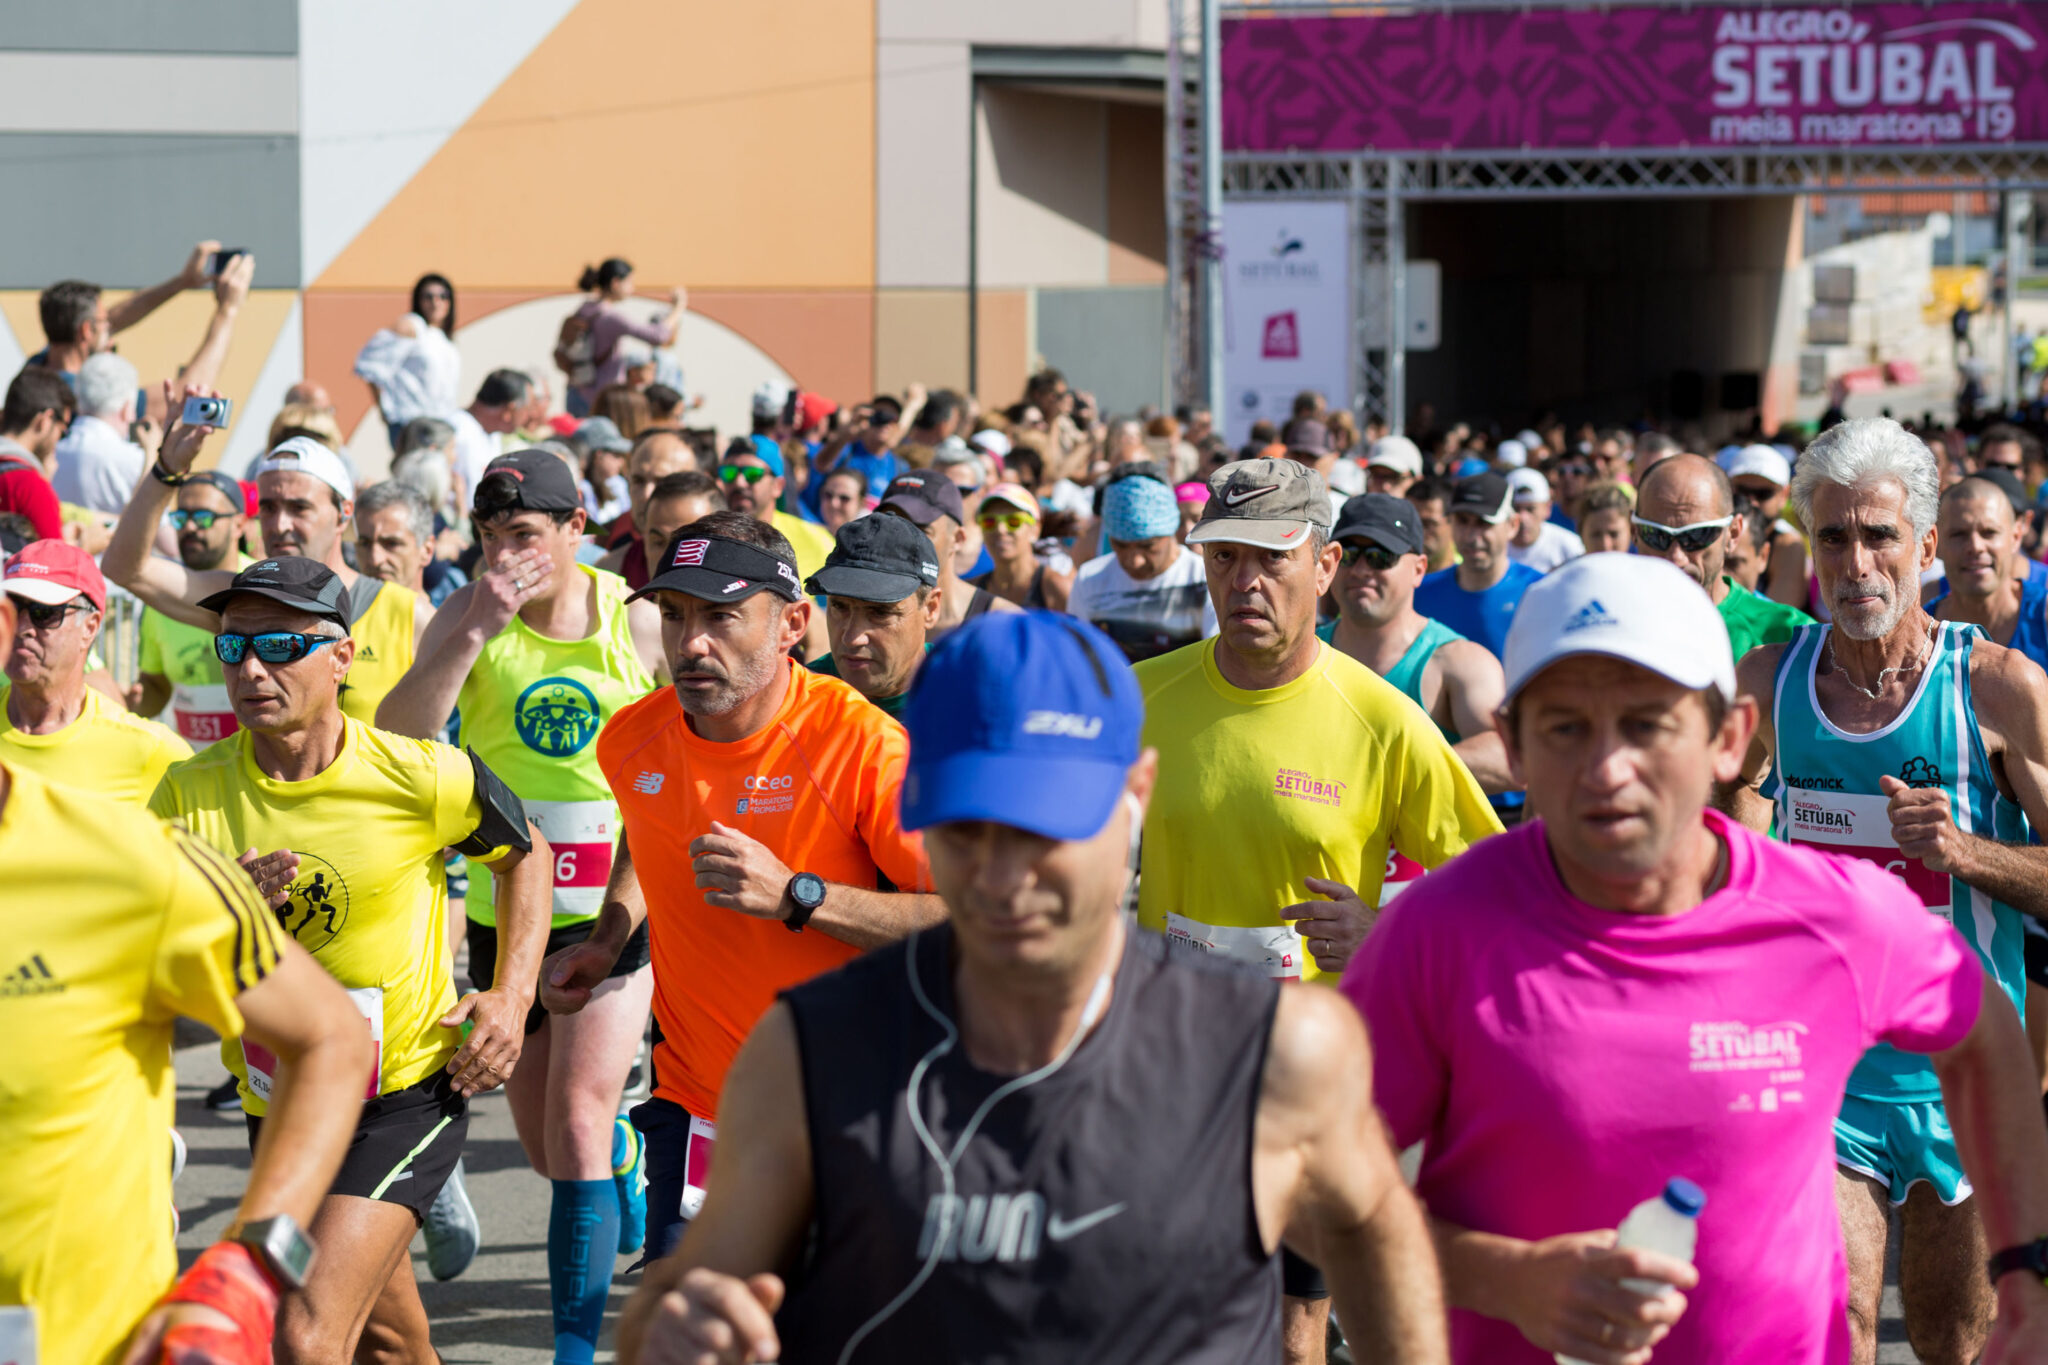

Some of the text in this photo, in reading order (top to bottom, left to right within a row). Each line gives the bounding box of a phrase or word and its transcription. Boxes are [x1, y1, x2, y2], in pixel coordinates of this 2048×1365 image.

[1716, 10, 1852, 43] ALEGRO
[1711, 23, 2014, 108] SETÚBAL
[1710, 110, 1794, 142] meia
[190, 716, 221, 739] 351
[1794, 807, 1853, 827] SETÚBAL
